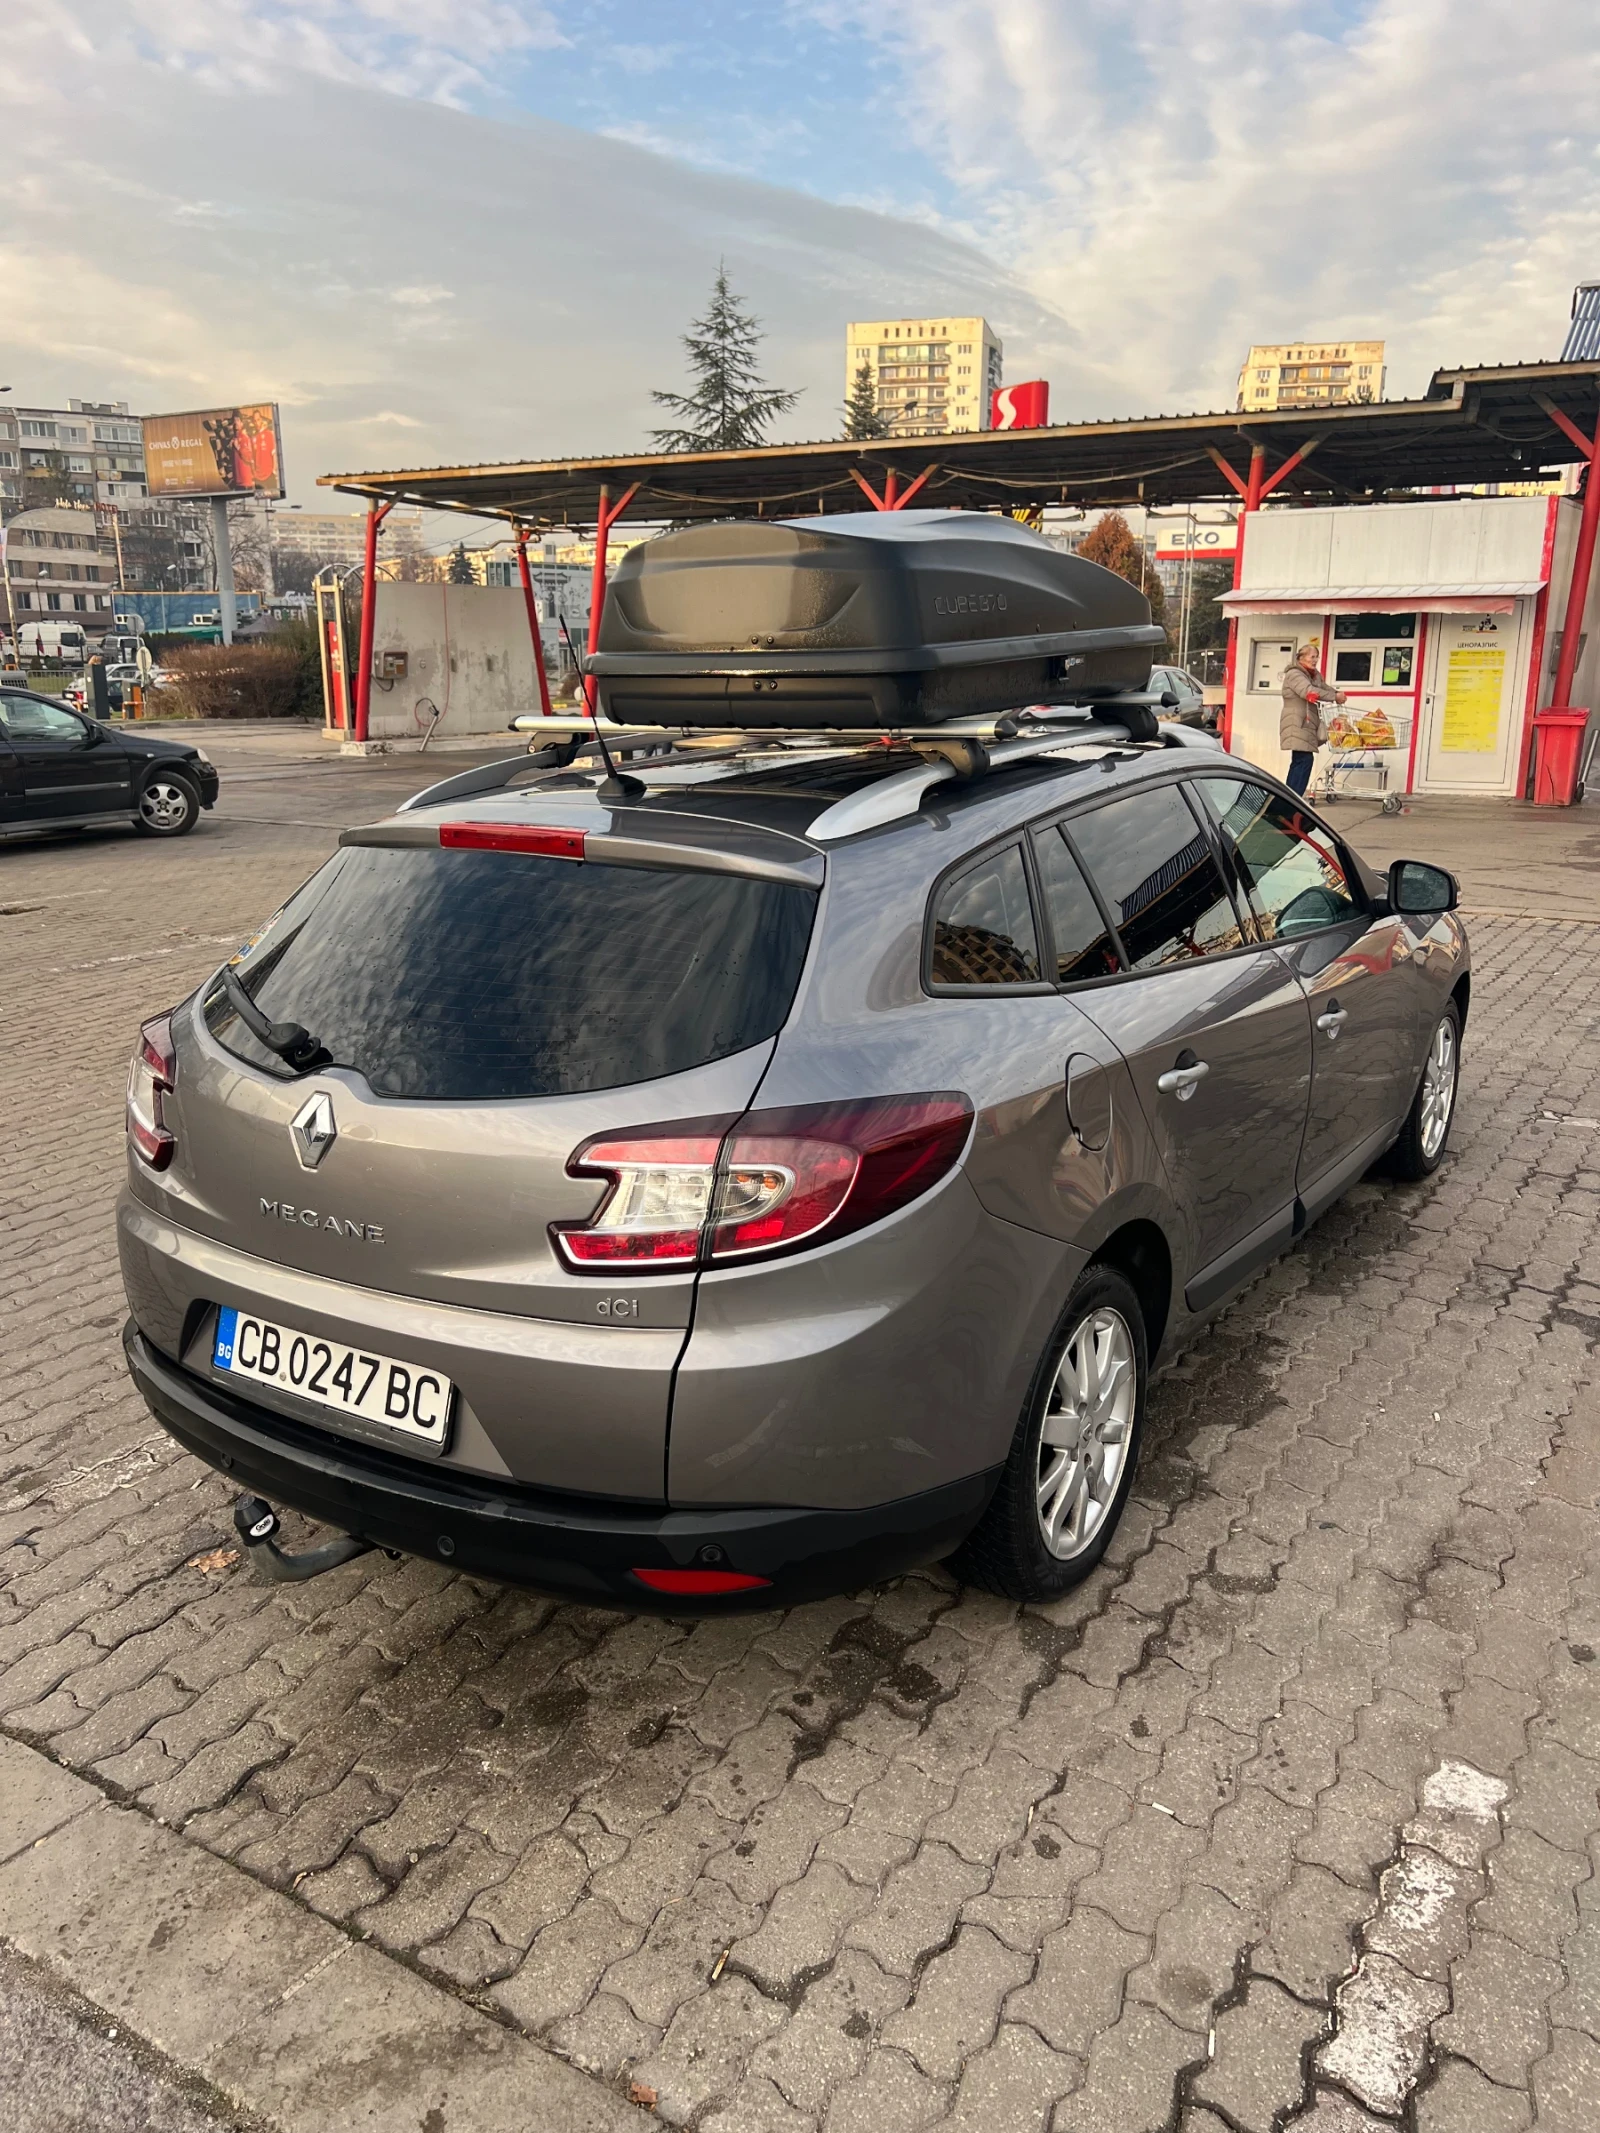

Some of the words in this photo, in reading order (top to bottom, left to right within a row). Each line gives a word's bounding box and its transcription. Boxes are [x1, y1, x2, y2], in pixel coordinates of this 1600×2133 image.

[149, 441, 171, 450] CHIVAS
[181, 438, 203, 448] REGAL
[1171, 531, 1220, 546] EKO
[1457, 641, 1499, 649] ЦЕНОРАЗПИС
[260, 1197, 386, 1244] MEGANE
[596, 1297, 640, 1318] dCi
[217, 1342, 232, 1360] BG
